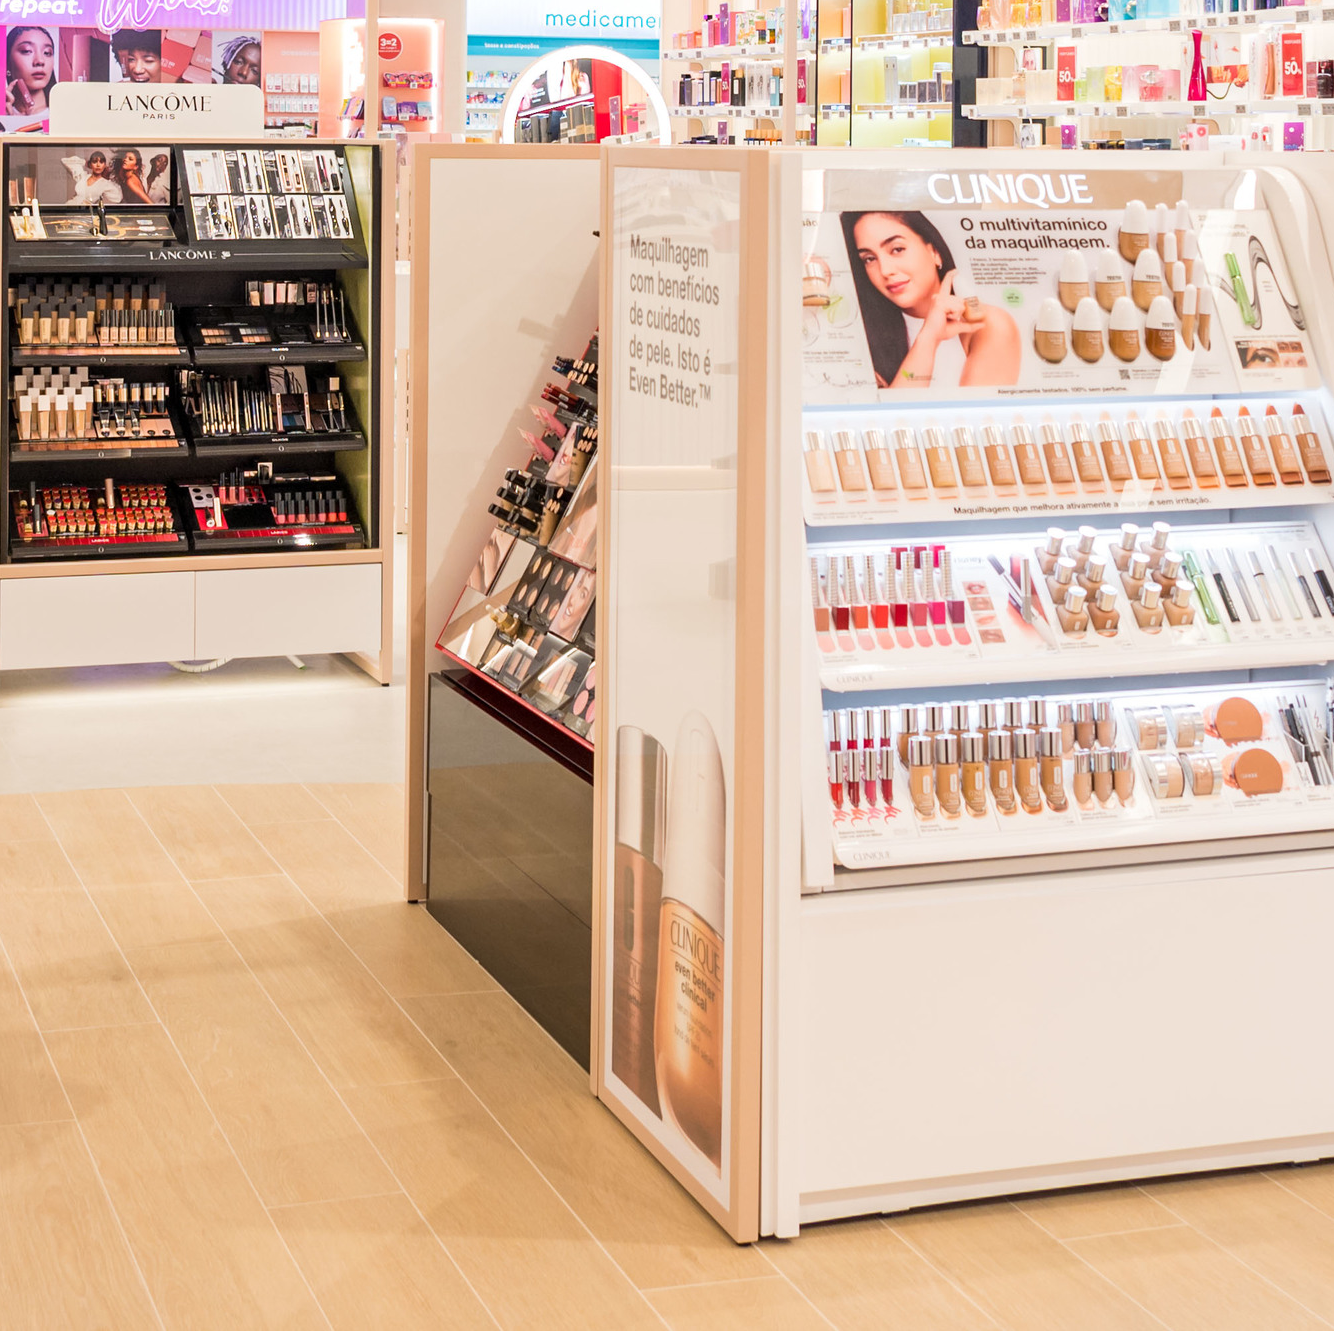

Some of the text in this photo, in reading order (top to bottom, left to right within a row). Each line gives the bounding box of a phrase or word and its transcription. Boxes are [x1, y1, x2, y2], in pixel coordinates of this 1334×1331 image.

[107, 91, 212, 113] LANCÔME
[142, 112, 176, 120] PARIS
[927, 173, 1093, 209] CLINIQUE
[960, 217, 1107, 231] O multivitamínico
[150, 249, 217, 260] LANCÔME
[630, 234, 709, 272] Maquilhagem
[965, 235, 1110, 252] da maquilhagem.
[629, 272, 720, 306] com benefícios
[629, 301, 700, 337] de cuidados
[629, 333, 711, 376] de pele. Isto é
[629, 366, 657, 395] Even
[954, 505, 1010, 515] Maquilhagem
[1013, 505, 1028, 513] que
[1030, 502, 1064, 511] melhora
[1067, 500, 1111, 509] ativamente
[1175, 496, 1212, 505] irritação.
[670, 920, 721, 982] CLINIQUE
[675, 960, 716, 1003] even better
[681, 981, 708, 1013] clinical
